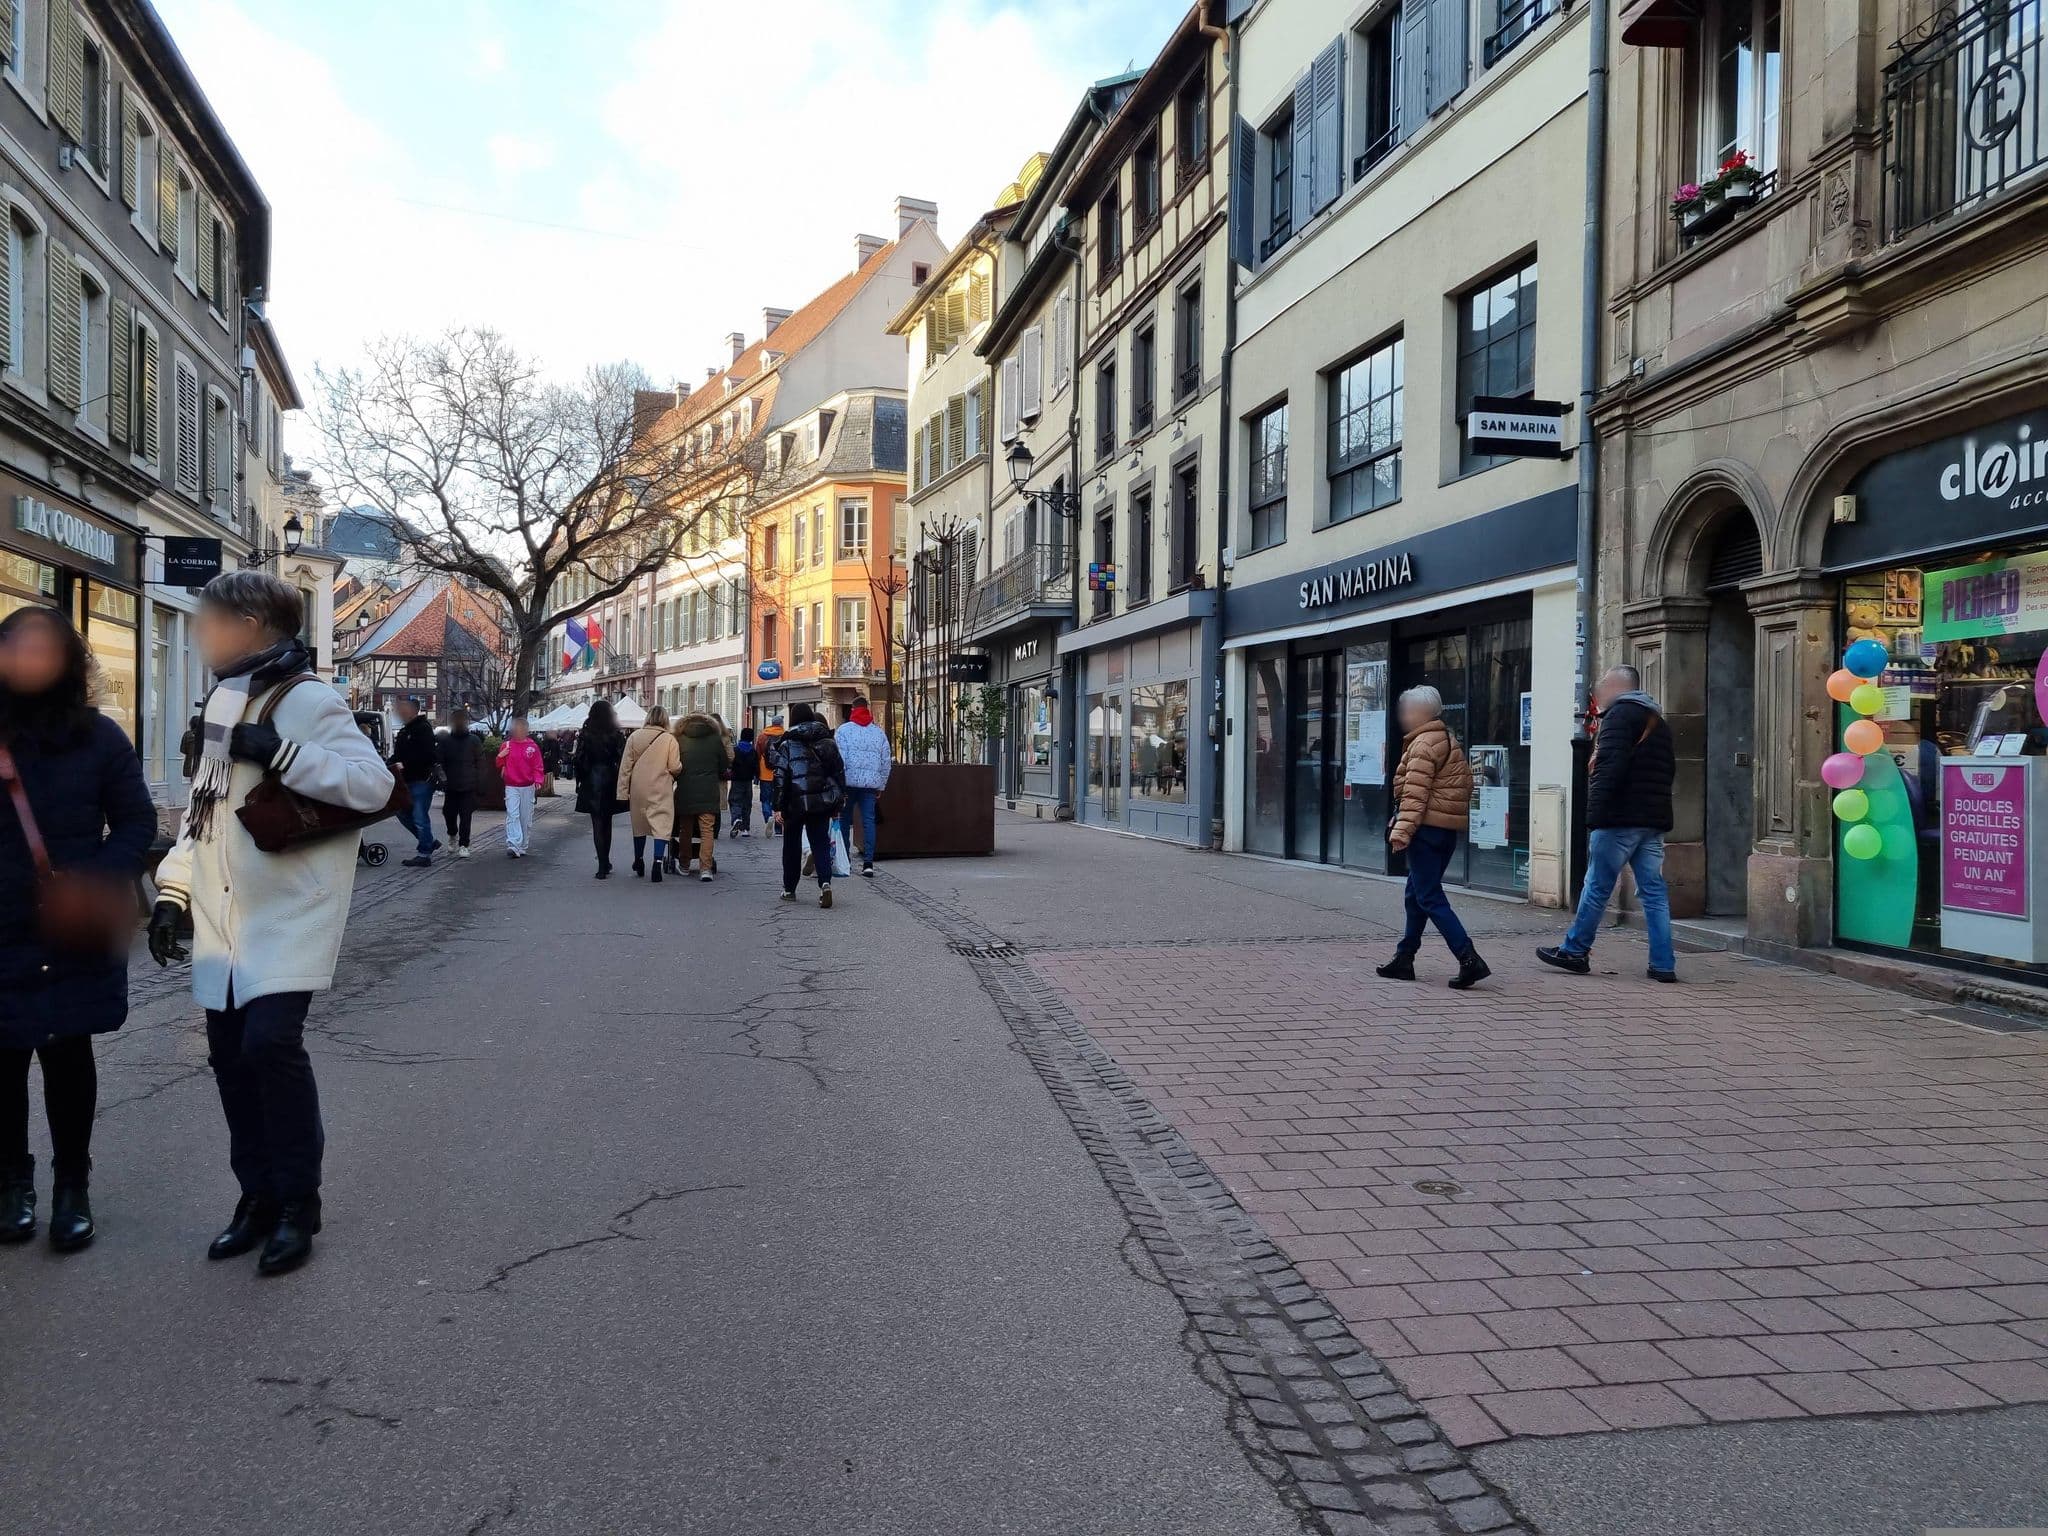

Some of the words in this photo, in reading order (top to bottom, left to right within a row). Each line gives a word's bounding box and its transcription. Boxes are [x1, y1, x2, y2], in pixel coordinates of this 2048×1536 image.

[1480, 420, 1506, 432] SAN
[1510, 421, 1557, 435] MARINA
[2009, 490, 2048, 510] acc
[17, 495, 52, 539] LA
[48, 508, 115, 566] CORRIDA
[181, 558, 217, 566] CORRIDA
[1299, 575, 1334, 609] SAN
[1340, 552, 1412, 600] MARINA
[1015, 639, 1038, 661] MATY
[1954, 798, 2013, 814] BOUCLES
[1948, 813, 2020, 830] D'OREILLES
[1950, 830, 2018, 848] GRATUITES
[1954, 847, 2014, 865] PENDANT
[1964, 866, 1981, 880] UN
